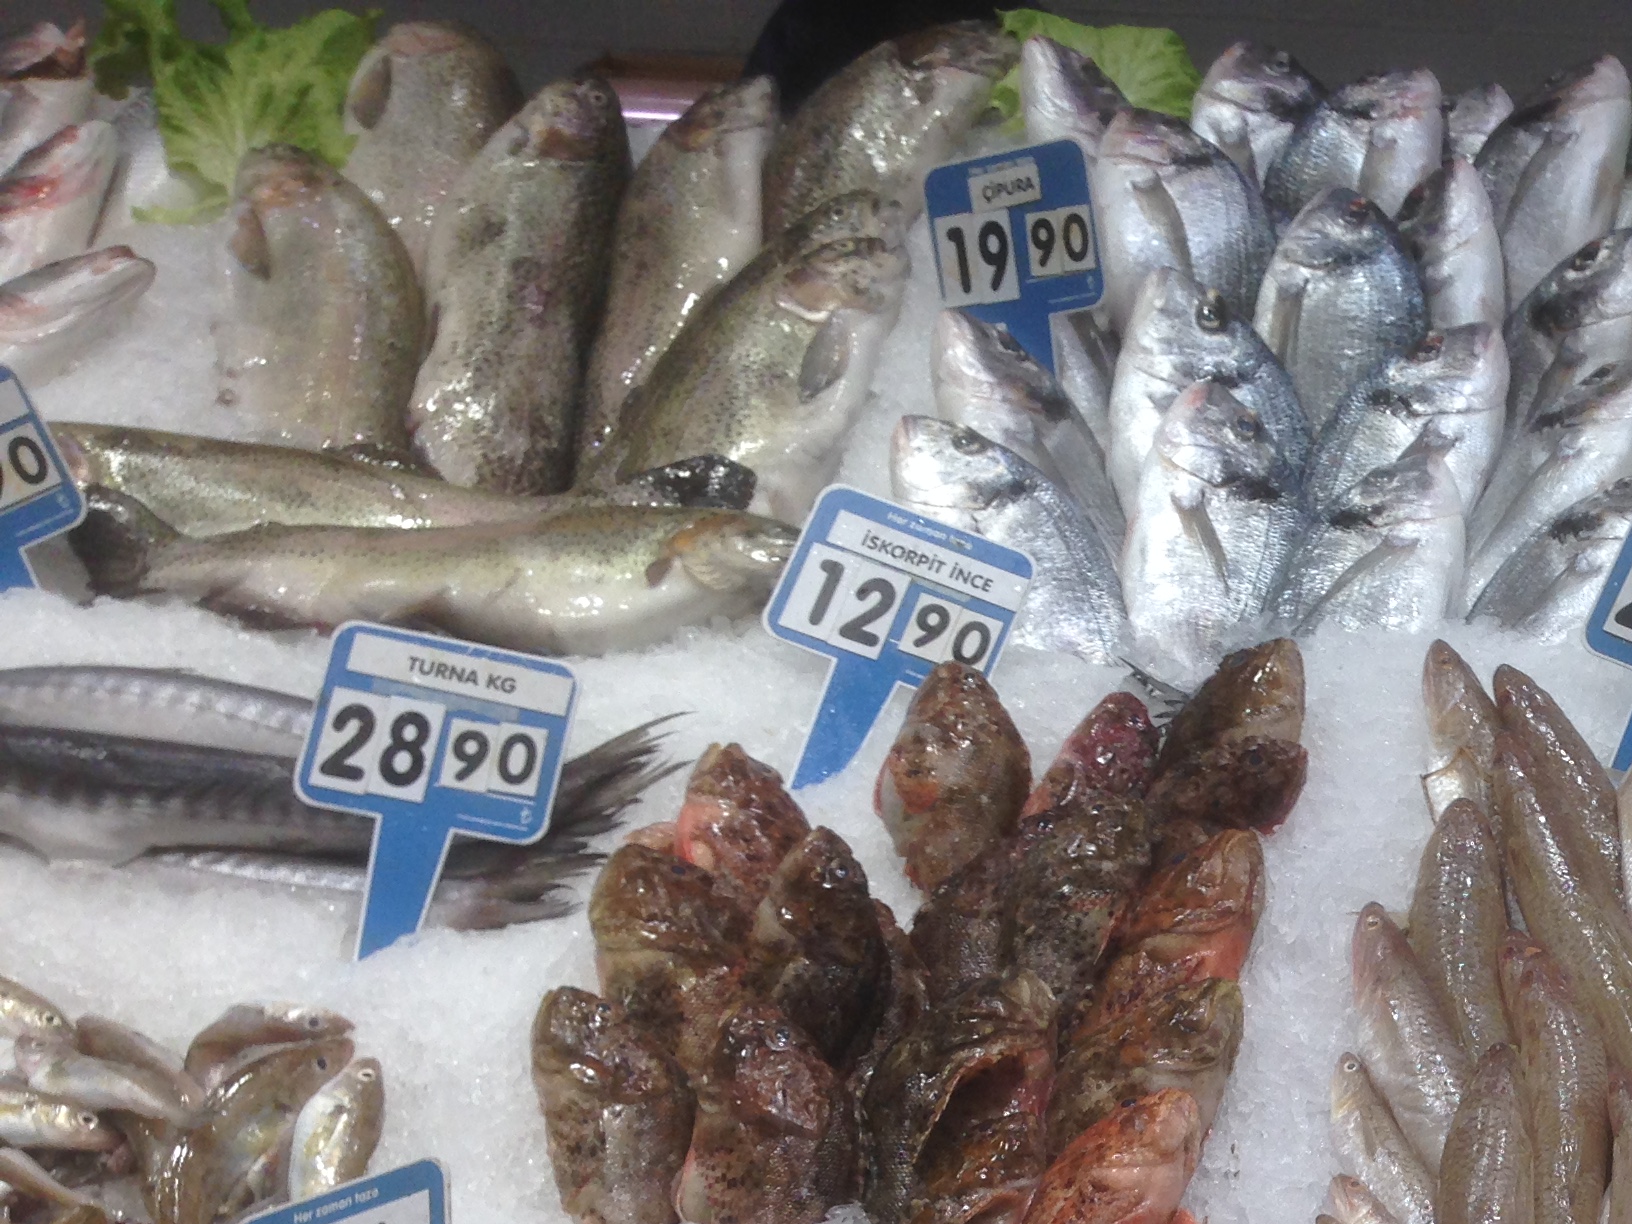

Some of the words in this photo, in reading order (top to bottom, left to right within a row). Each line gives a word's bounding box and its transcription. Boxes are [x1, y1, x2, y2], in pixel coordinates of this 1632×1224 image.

[946, 220, 1008, 294] 19
[1031, 213, 1089, 268] 90
[0, 436, 48, 494] 0
[861, 529, 946, 575] İSKORPİT
[949, 562, 994, 593] İNCE
[808, 559, 896, 648] 12
[913, 604, 992, 666] 90
[408, 656, 479, 686] TURNA
[486, 673, 517, 694] KG
[318, 703, 431, 788] 28
[453, 729, 538, 785] 90
[293, 1209, 313, 1224] Her
[316, 1198, 353, 1218] zaman
[354, 1187, 379, 1204] taze
